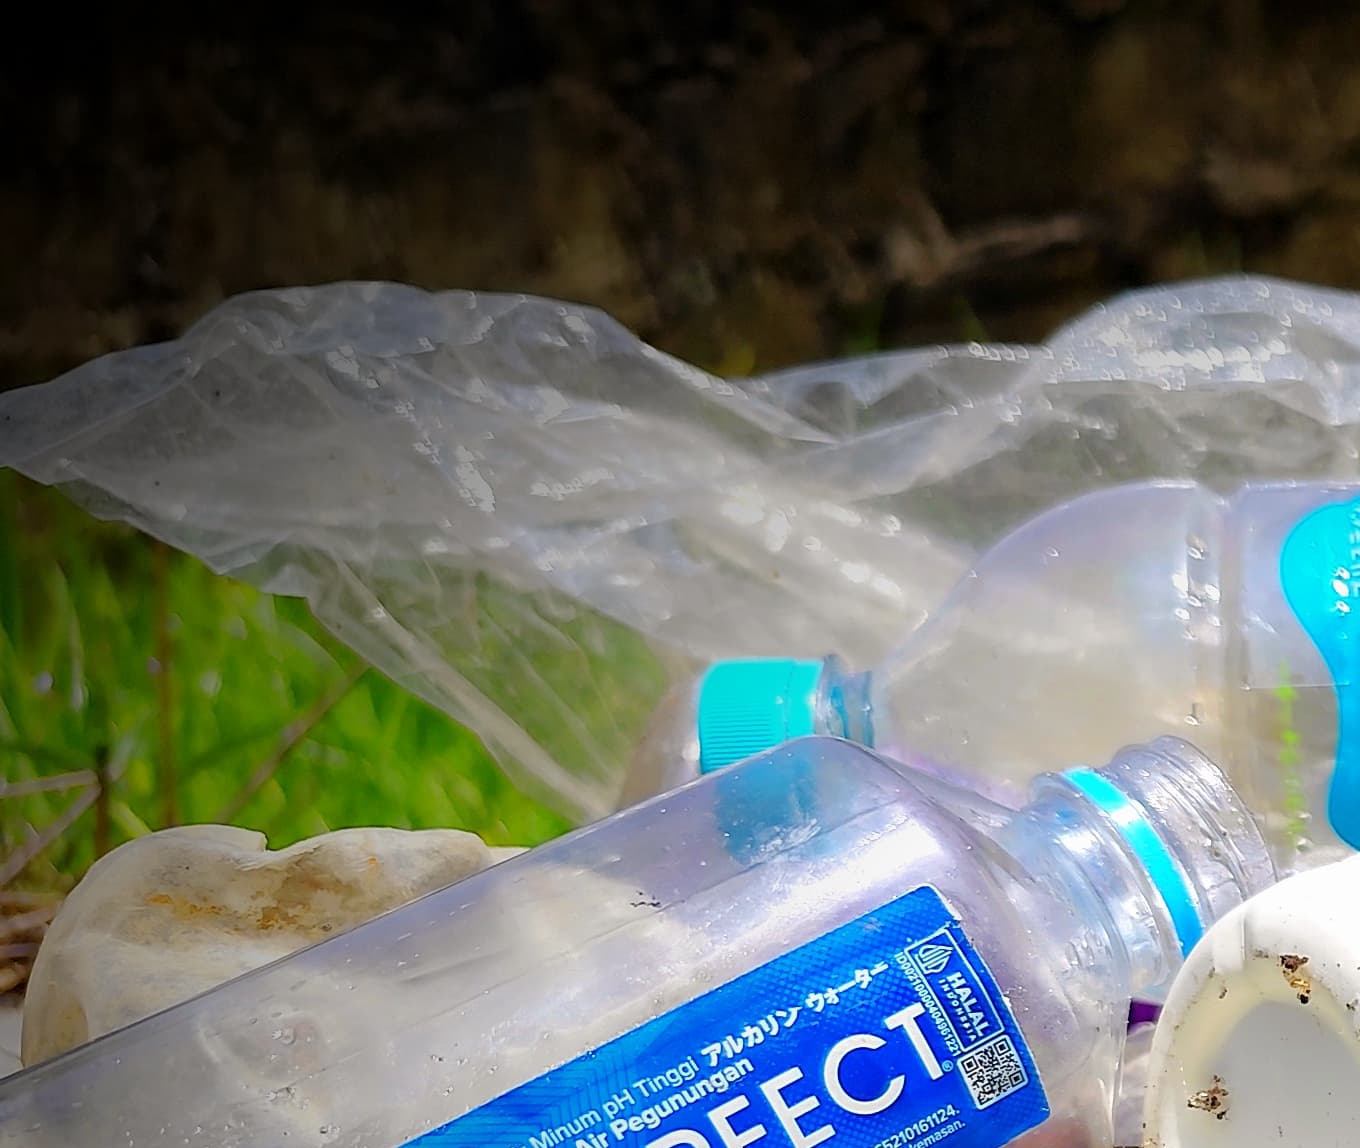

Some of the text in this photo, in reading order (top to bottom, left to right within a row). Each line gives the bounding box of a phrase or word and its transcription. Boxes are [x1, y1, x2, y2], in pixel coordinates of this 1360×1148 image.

[947, 968, 993, 1039] HALAL
[601, 1088, 637, 1120] pH
[634, 1054, 700, 1101] Tinggi
[609, 1053, 756, 1142] Pegunungan
